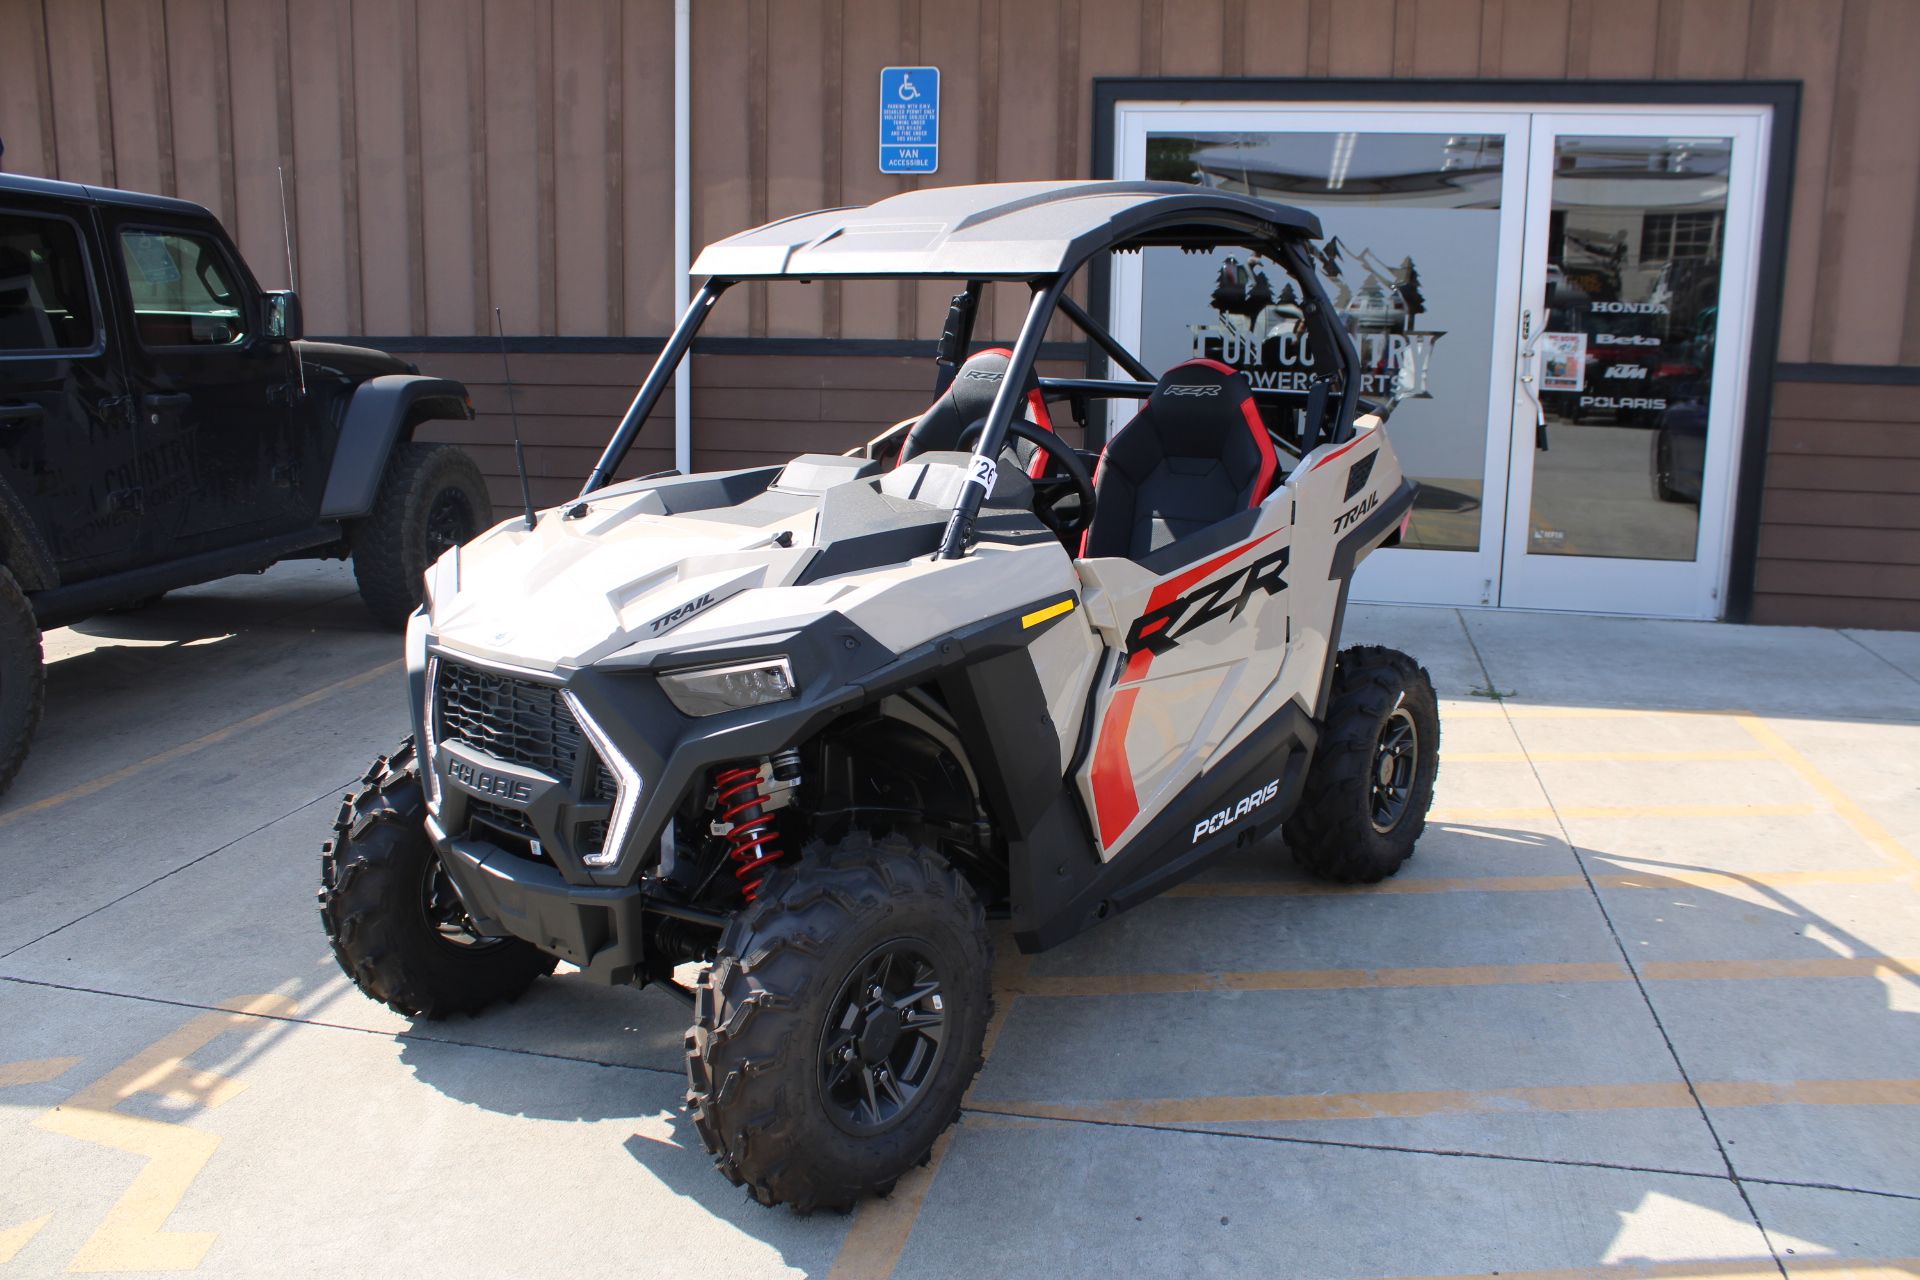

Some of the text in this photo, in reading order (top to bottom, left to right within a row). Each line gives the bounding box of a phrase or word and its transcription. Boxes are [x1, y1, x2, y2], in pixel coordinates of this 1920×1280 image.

[899, 149, 919, 159] VAN
[888, 159, 929, 167] ACCESSIBLE
[1591, 302, 1670, 314] HONDA
[1596, 334, 1661, 346] Beta
[1605, 364, 1648, 379] KTM
[1163, 384, 1222, 397] RZR
[1579, 396, 1667, 410] POLARIS
[1333, 490, 1379, 535] TRAIL
[1125, 545, 1290, 657] RZR
[649, 593, 715, 632] TRAIL
[447, 757, 533, 804] POLARIS
[1192, 779, 1280, 844] POLARIS
